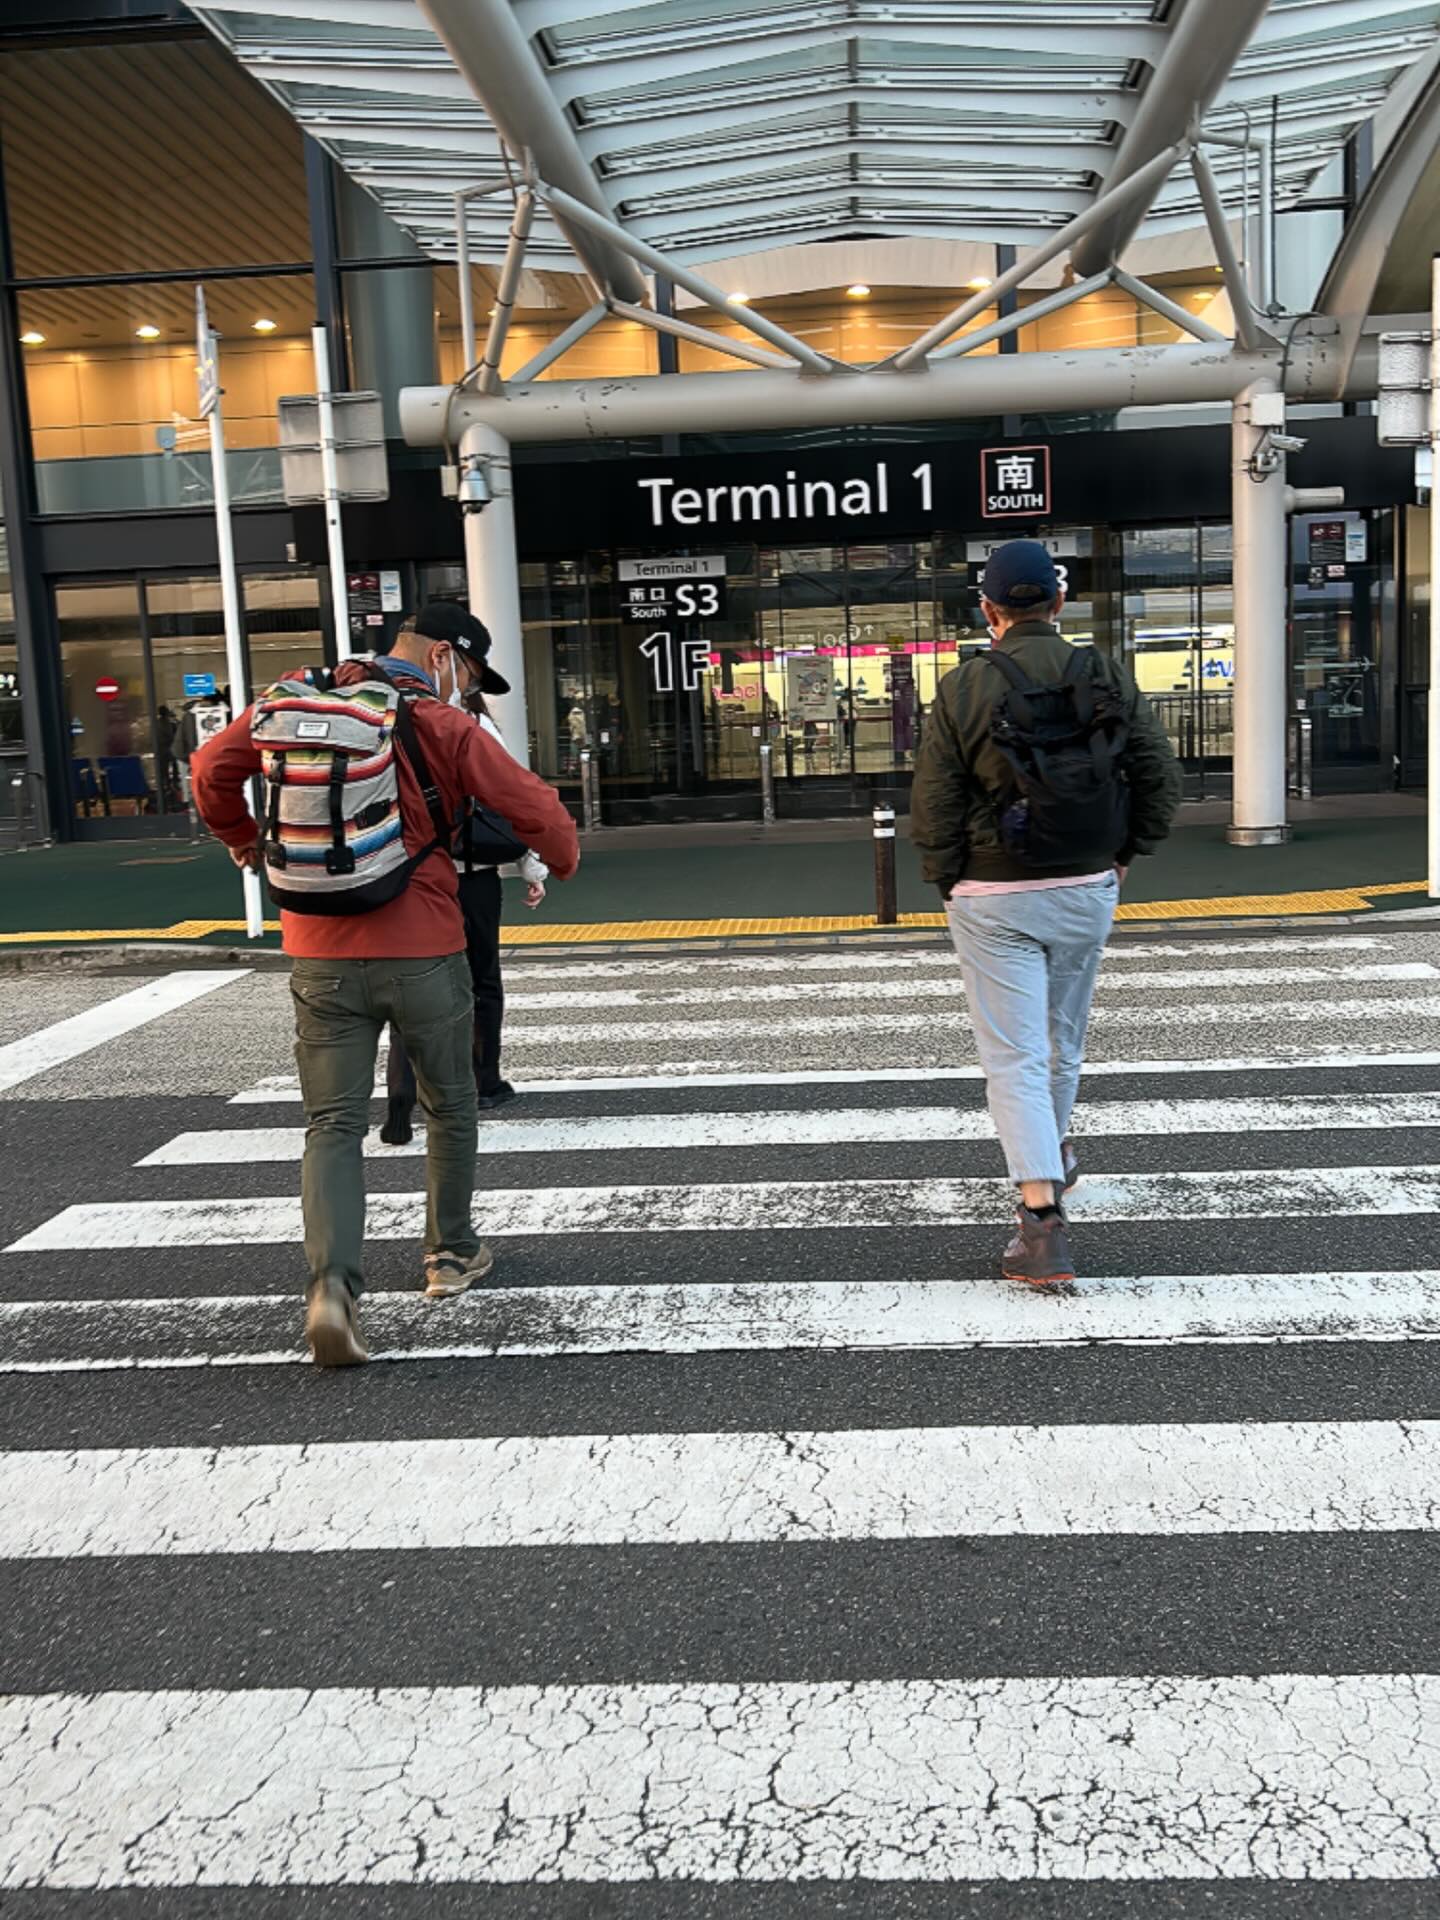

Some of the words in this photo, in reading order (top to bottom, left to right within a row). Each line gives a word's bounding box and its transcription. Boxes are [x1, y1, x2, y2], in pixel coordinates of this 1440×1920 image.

[995, 455, 1036, 491] 南
[637, 462, 888, 526] Terminal
[911, 462, 933, 511] 1
[988, 493, 1044, 511] SOUTH
[634, 561, 697, 576] Terminal
[701, 561, 709, 573] 1
[631, 607, 667, 619] South
[675, 584, 720, 616] S3
[638, 632, 711, 692] 1F
